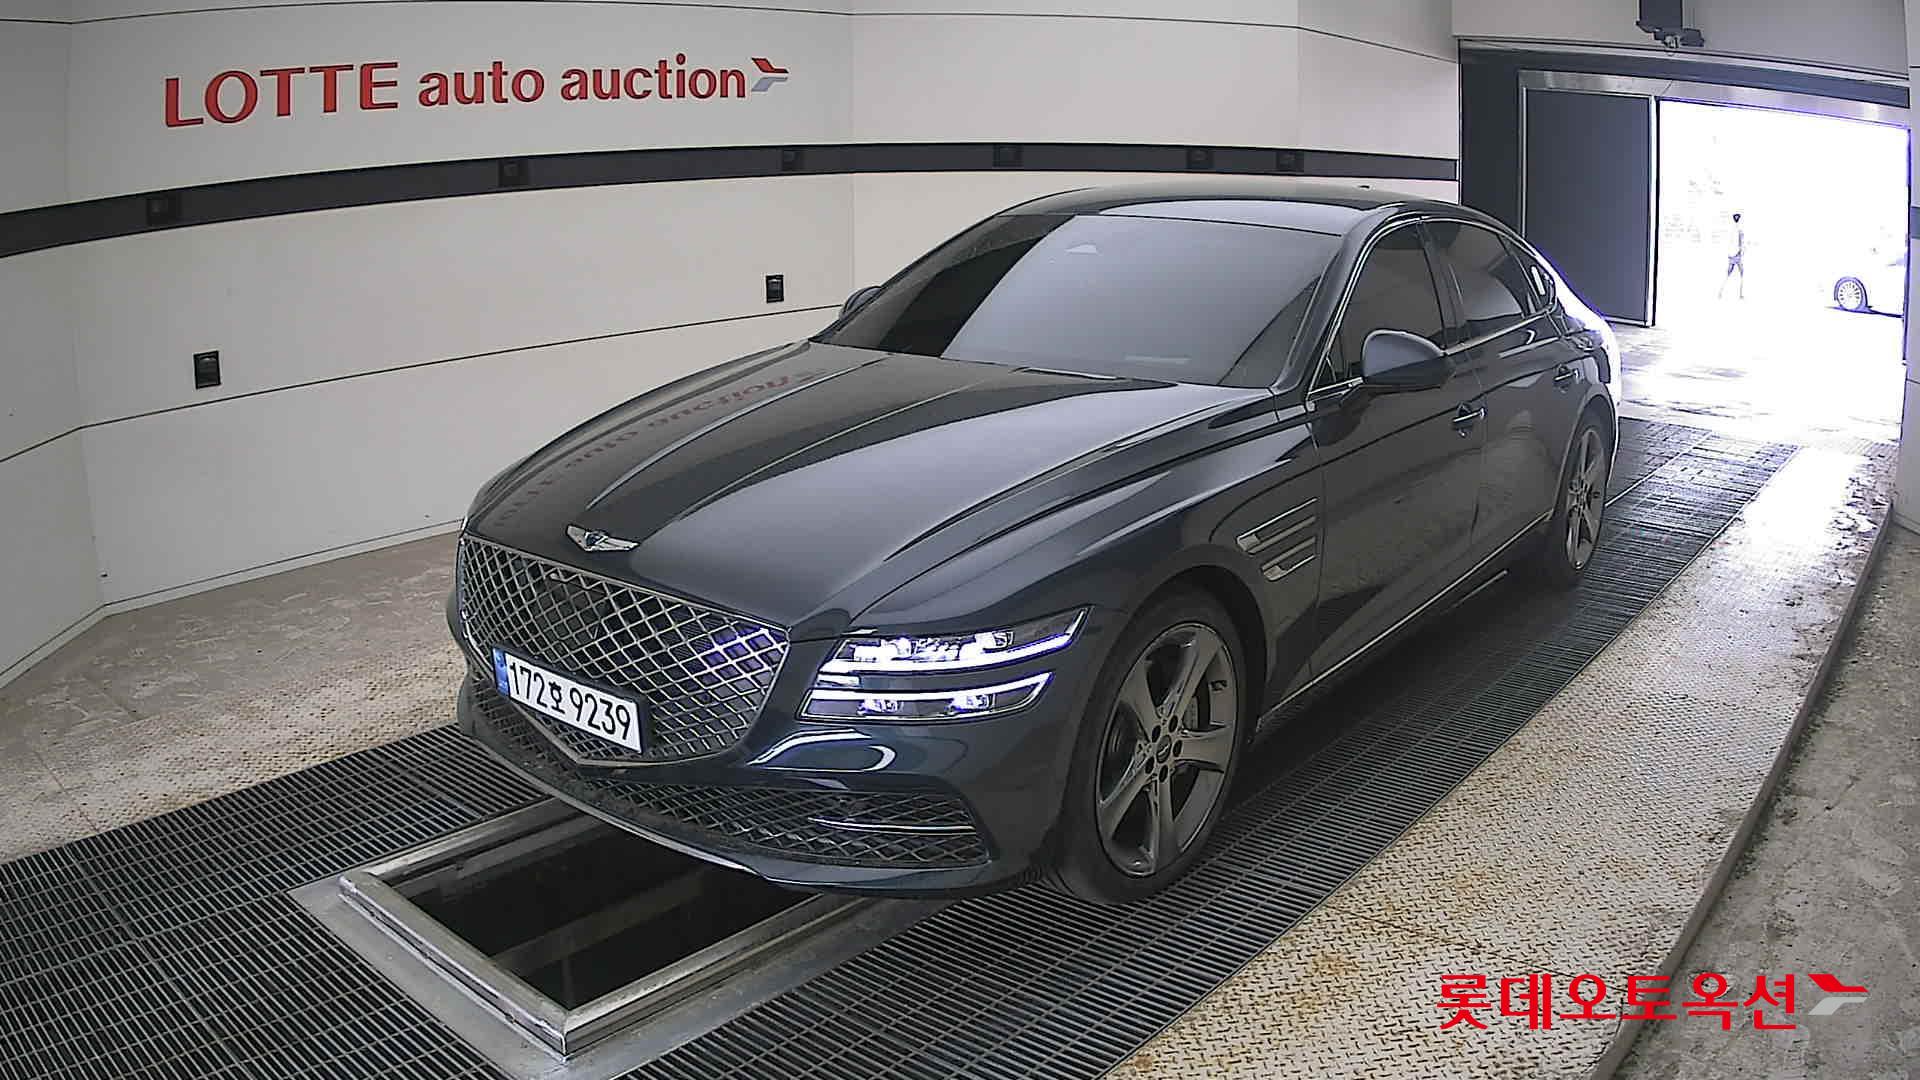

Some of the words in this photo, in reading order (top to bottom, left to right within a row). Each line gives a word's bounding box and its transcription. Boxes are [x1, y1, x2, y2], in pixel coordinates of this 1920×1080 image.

[164, 62, 398, 128] LOTTE
[418, 61, 545, 106] auto
[560, 53, 747, 100] auction
